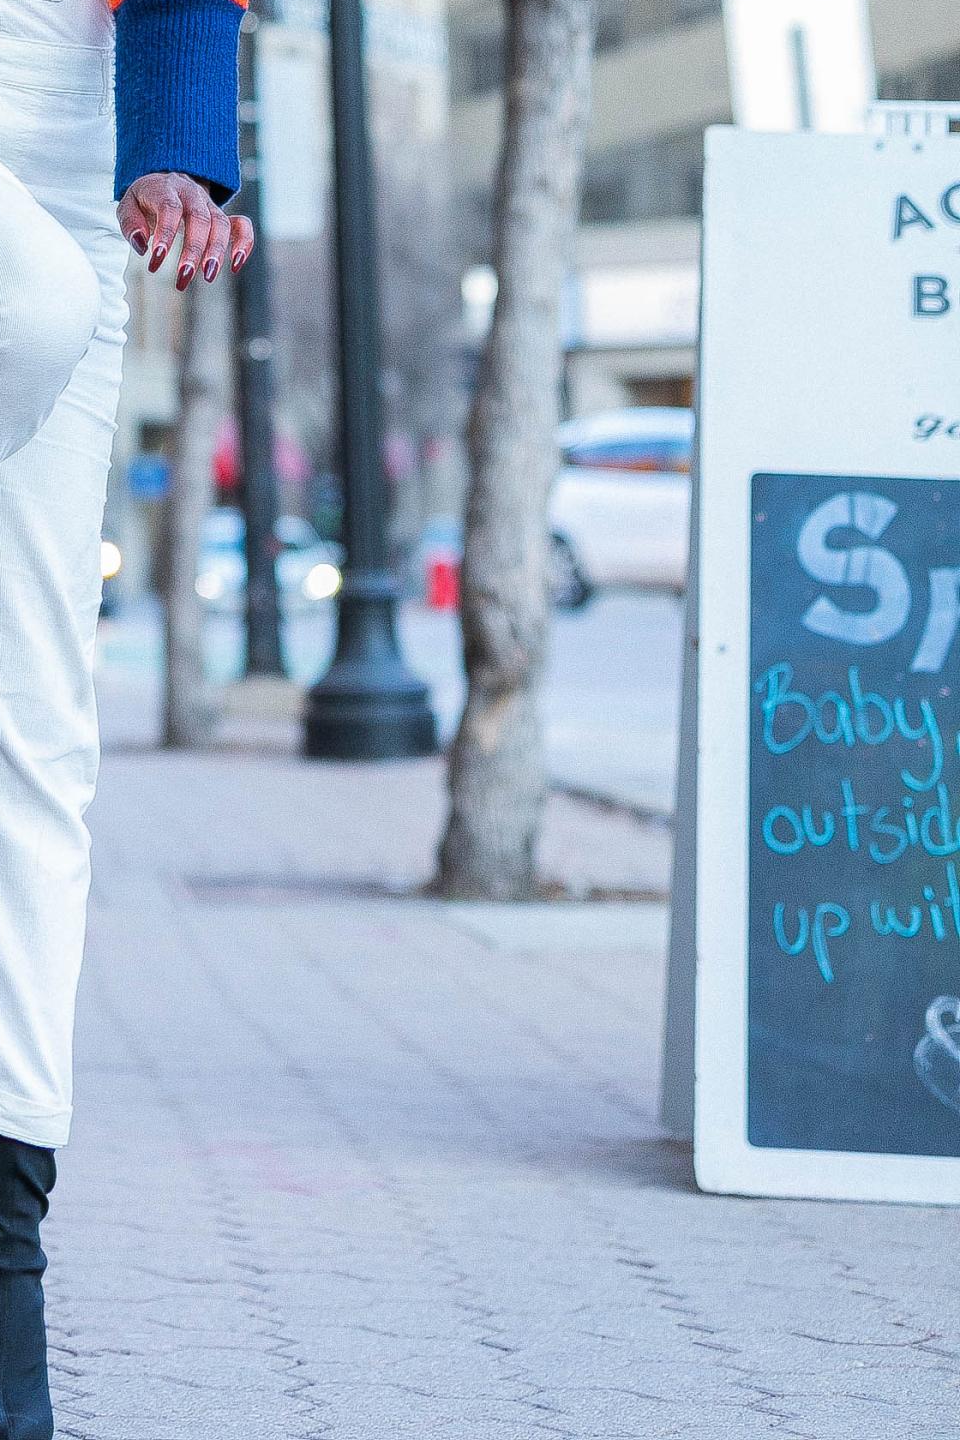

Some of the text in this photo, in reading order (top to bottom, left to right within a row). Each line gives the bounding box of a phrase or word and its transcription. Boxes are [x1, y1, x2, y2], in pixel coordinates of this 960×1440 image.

[911, 274, 960, 317] B
[753, 661, 944, 793] Baby
[762, 778, 960, 864] outsid
[773, 902, 851, 984] up
